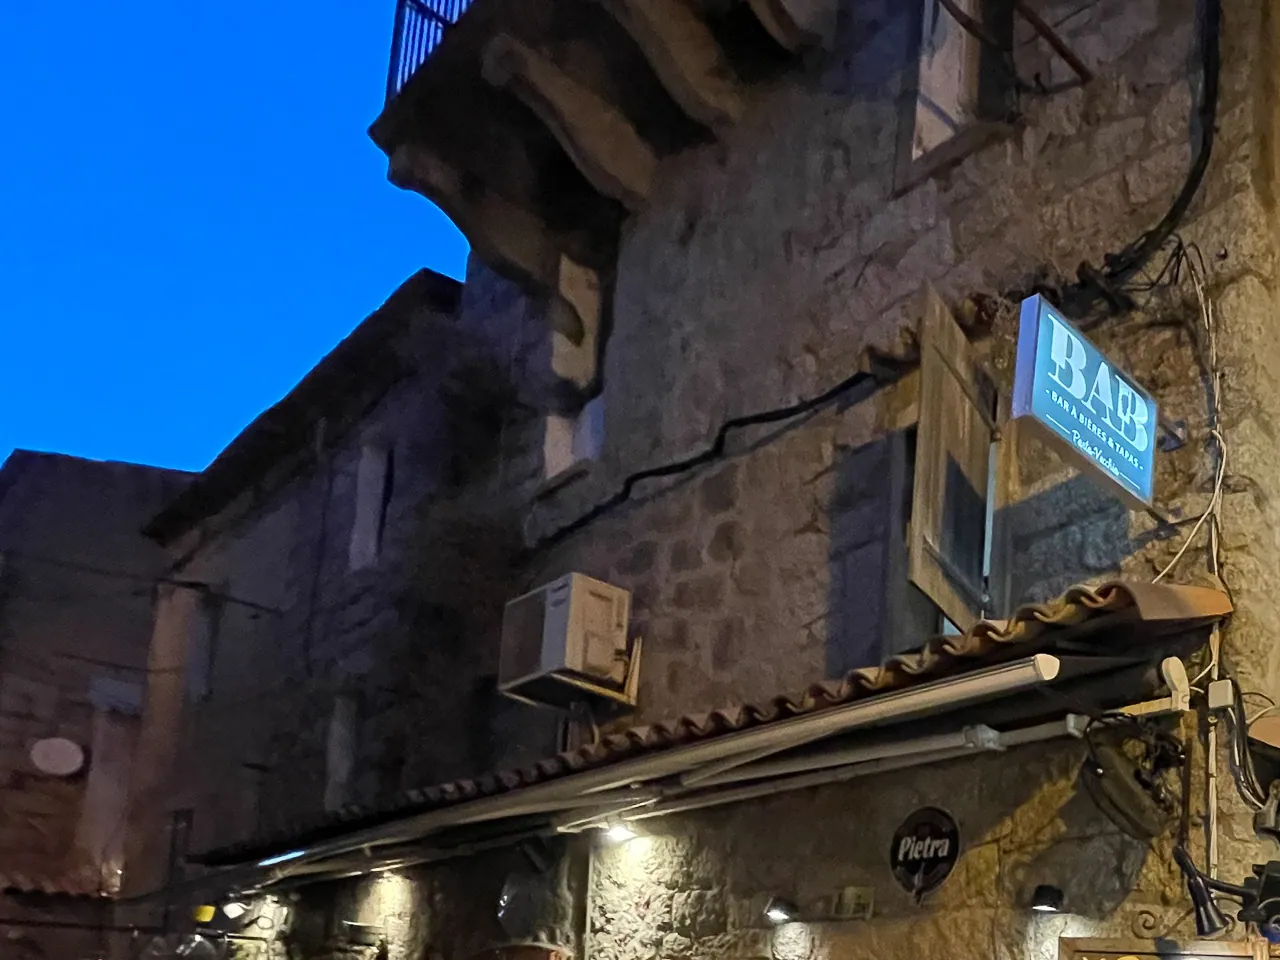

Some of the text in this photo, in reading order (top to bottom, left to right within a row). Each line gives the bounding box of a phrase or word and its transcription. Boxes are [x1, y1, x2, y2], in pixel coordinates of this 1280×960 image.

[1048, 314, 1149, 452] BAB
[1051, 388, 1070, 412] BAR
[1079, 411, 1107, 443] BIÈRES
[1107, 436, 1115, 449] &
[1115, 441, 1139, 469] TAPAS
[898, 836, 949, 861] Pietra
